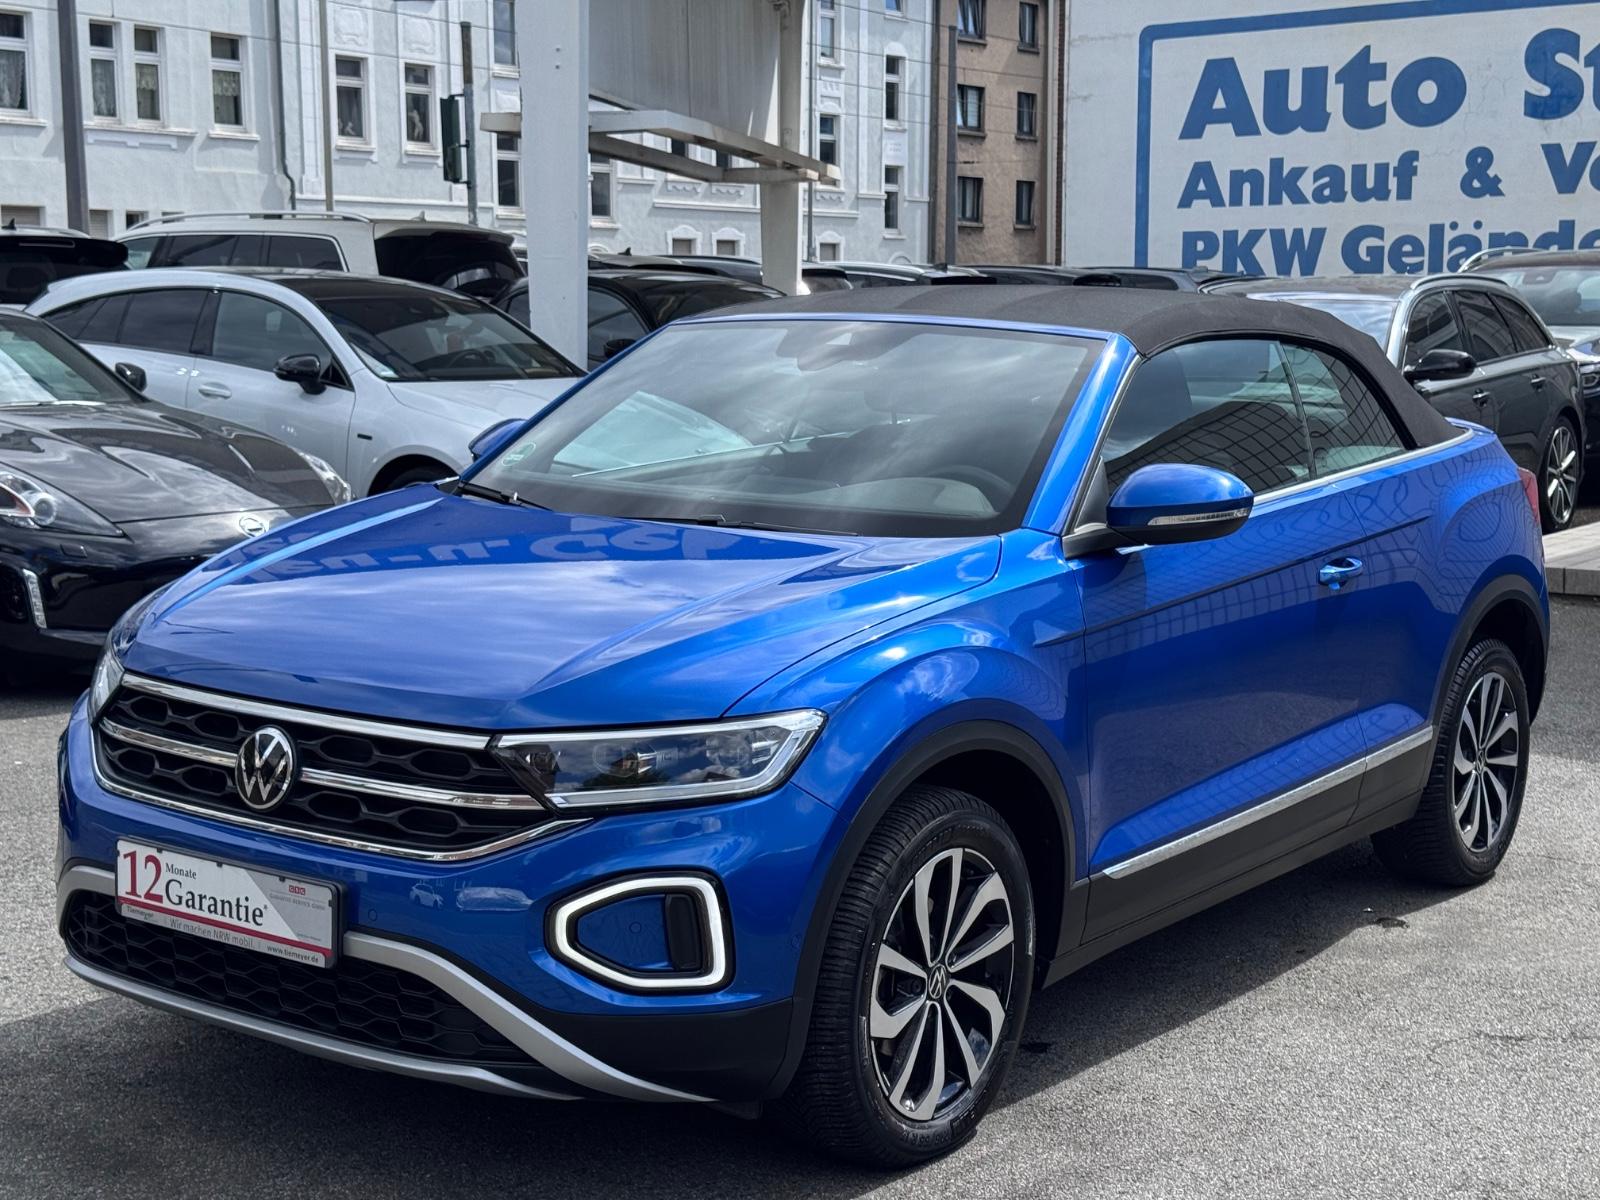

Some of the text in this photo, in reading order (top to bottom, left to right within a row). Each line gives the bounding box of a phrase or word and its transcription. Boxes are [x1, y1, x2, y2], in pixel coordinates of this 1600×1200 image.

[1178, 44, 1467, 140] Auto
[1177, 150, 1420, 209] Ankauf
[1460, 146, 1506, 199] &
[1181, 227, 1328, 277] PKW
[123, 850, 197, 904] 12 Monate
[170, 917, 182, 928] Wir
[183, 922, 212, 937] machen
[213, 929, 231, 942] NRW
[267, 945, 319, 964] www.tiemeyer.de
